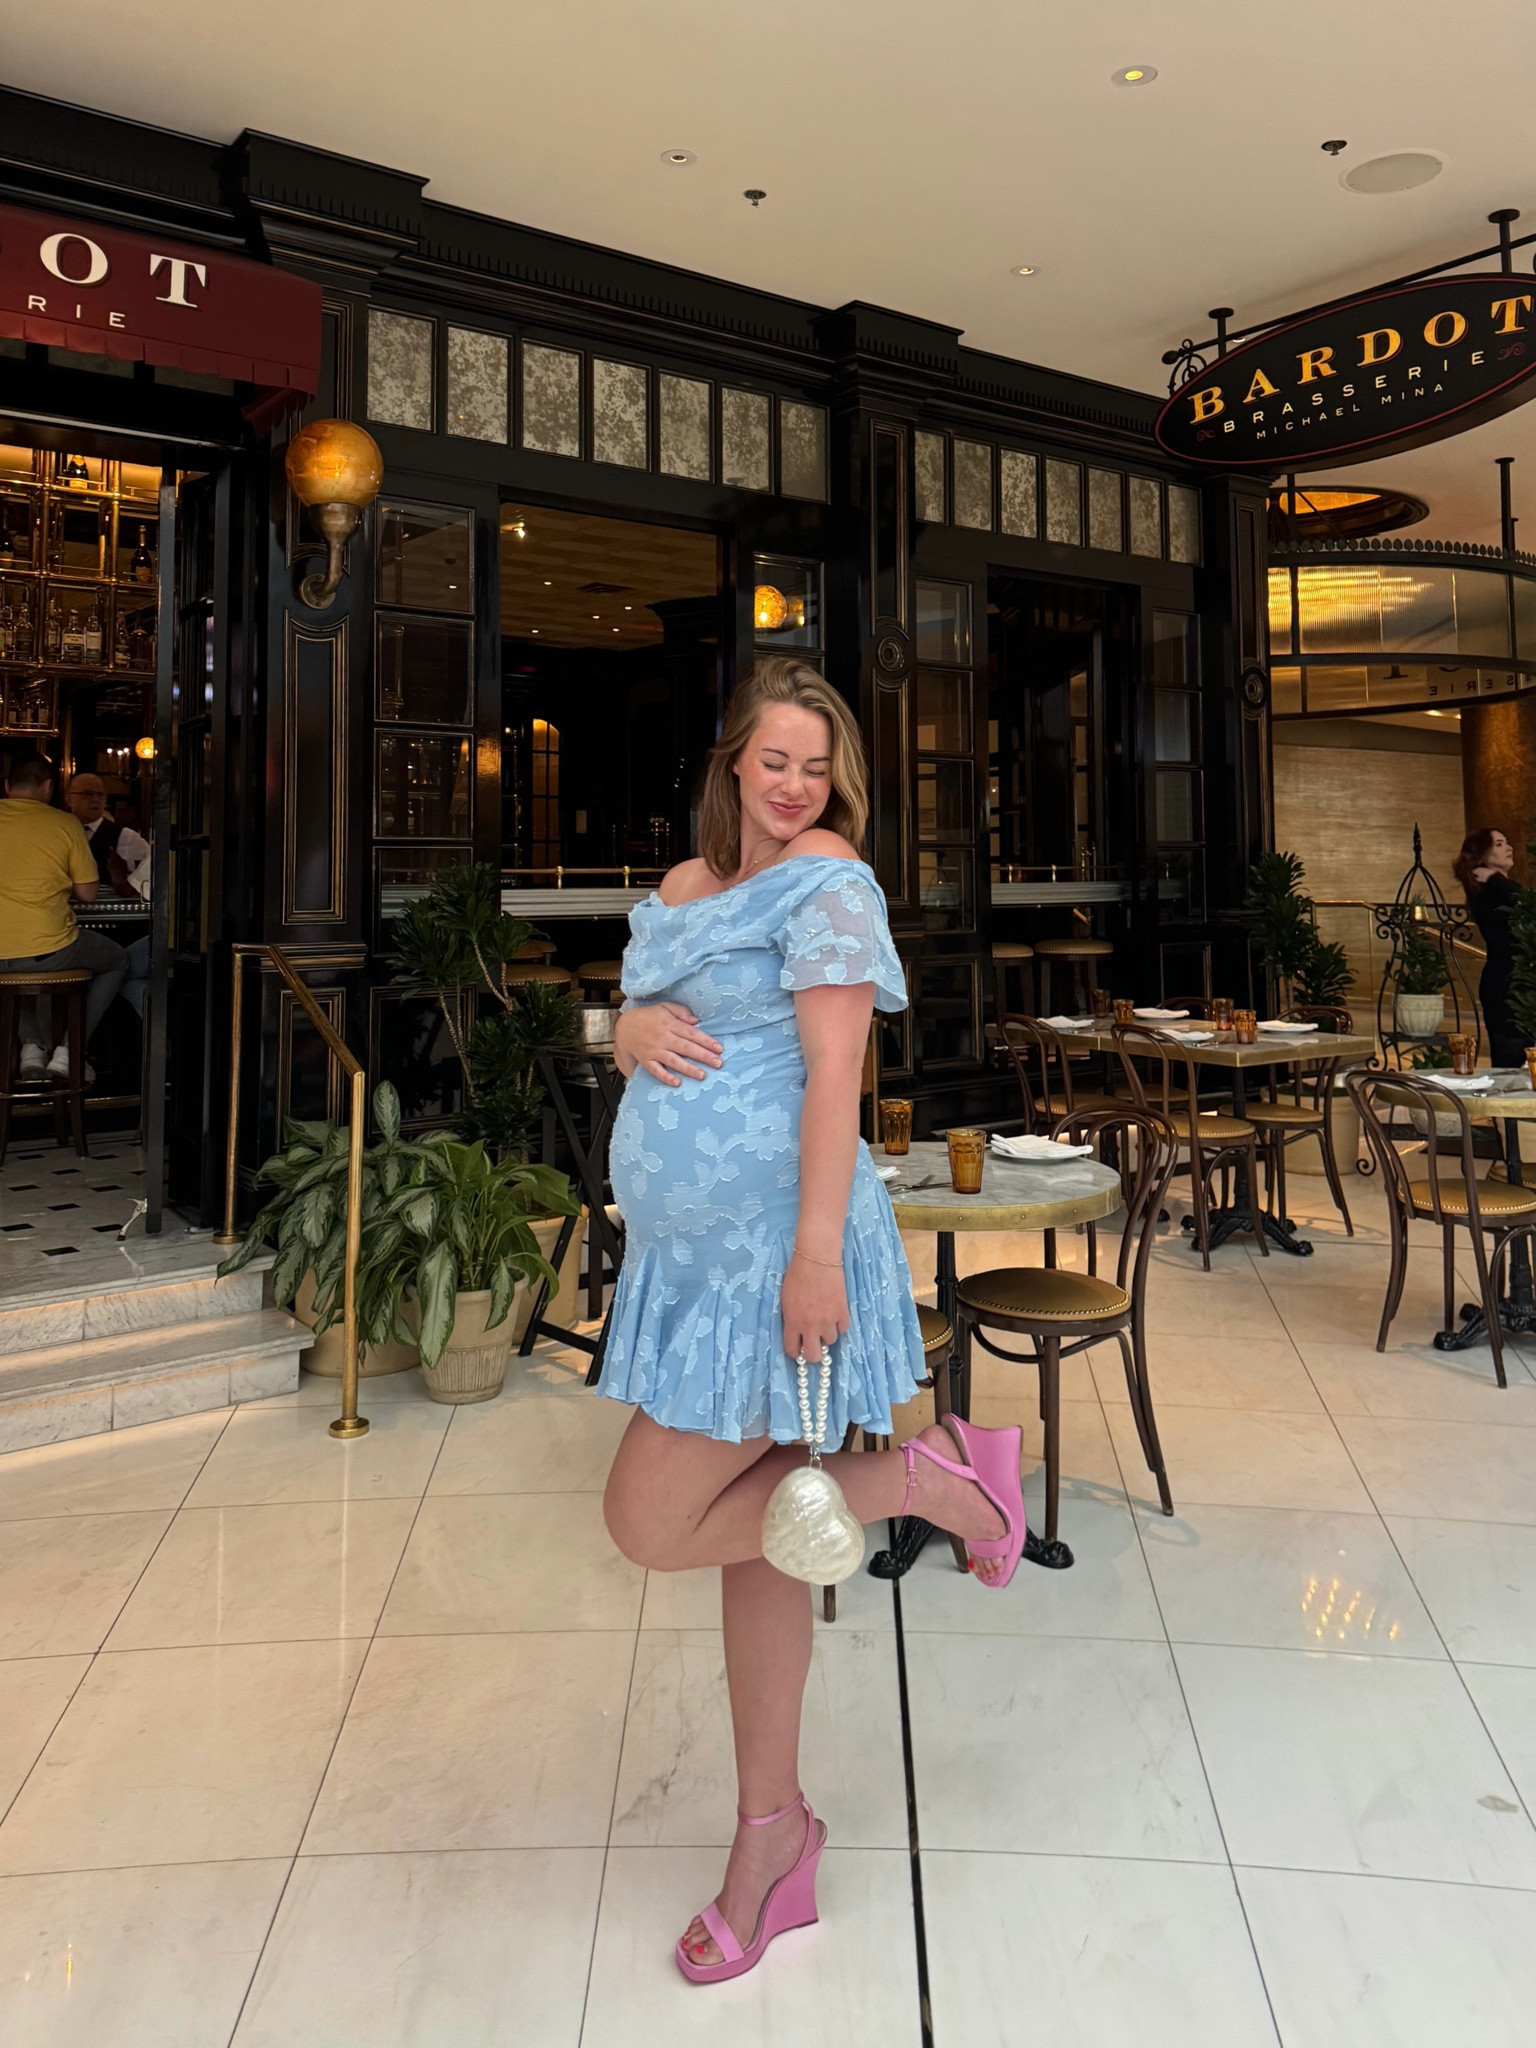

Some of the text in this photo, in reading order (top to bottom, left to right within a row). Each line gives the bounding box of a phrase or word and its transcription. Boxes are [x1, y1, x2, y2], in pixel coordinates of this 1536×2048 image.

[40, 232, 206, 308] OT
[28, 294, 126, 328] RIE
[1187, 294, 1532, 424] BARDOT
[1223, 350, 1485, 433] BRASSERIE
[1256, 383, 1443, 440] MICHAEL MINA
